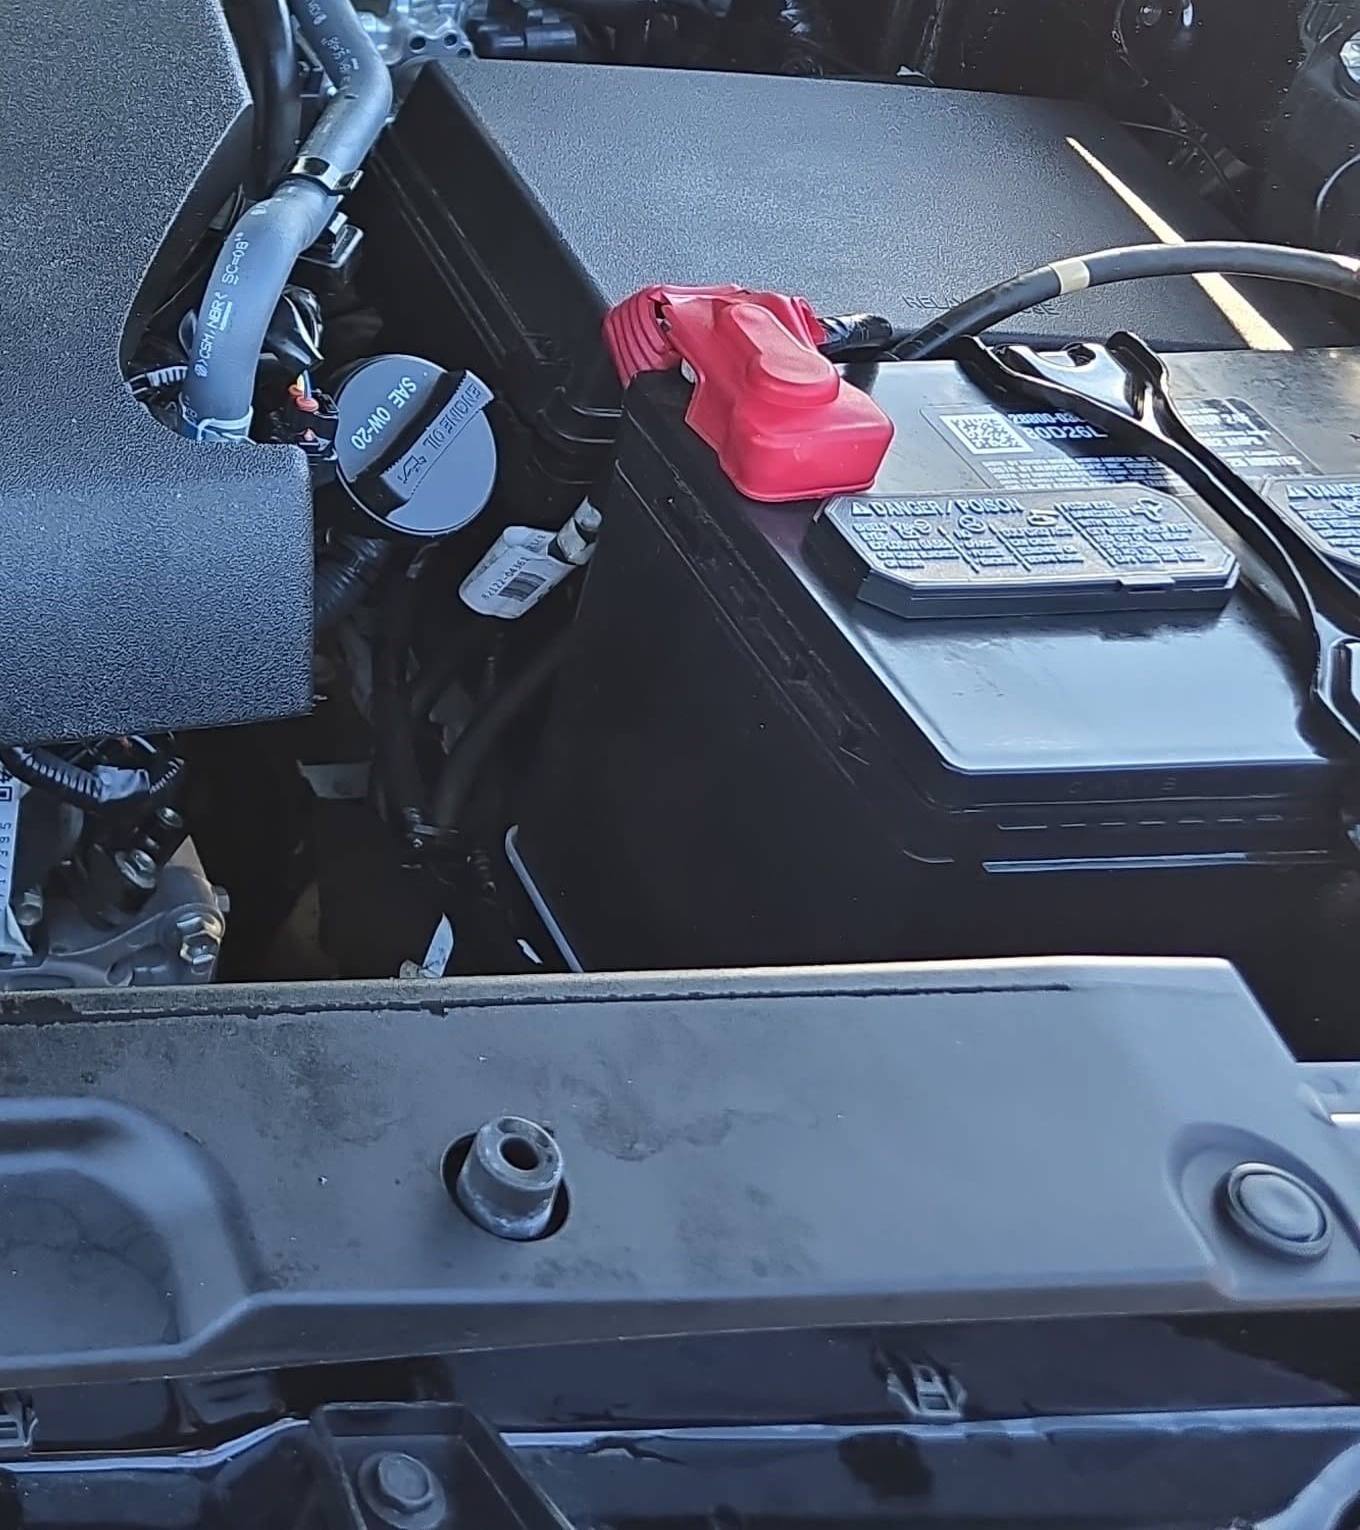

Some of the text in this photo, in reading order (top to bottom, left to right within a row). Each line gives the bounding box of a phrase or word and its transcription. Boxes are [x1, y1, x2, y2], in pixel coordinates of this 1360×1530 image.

[387, 376, 417, 409] SAE
[422, 383, 482, 450] ENGINE OIL
[869, 501, 943, 516] DANGER
[955, 497, 1024, 514] POISON
